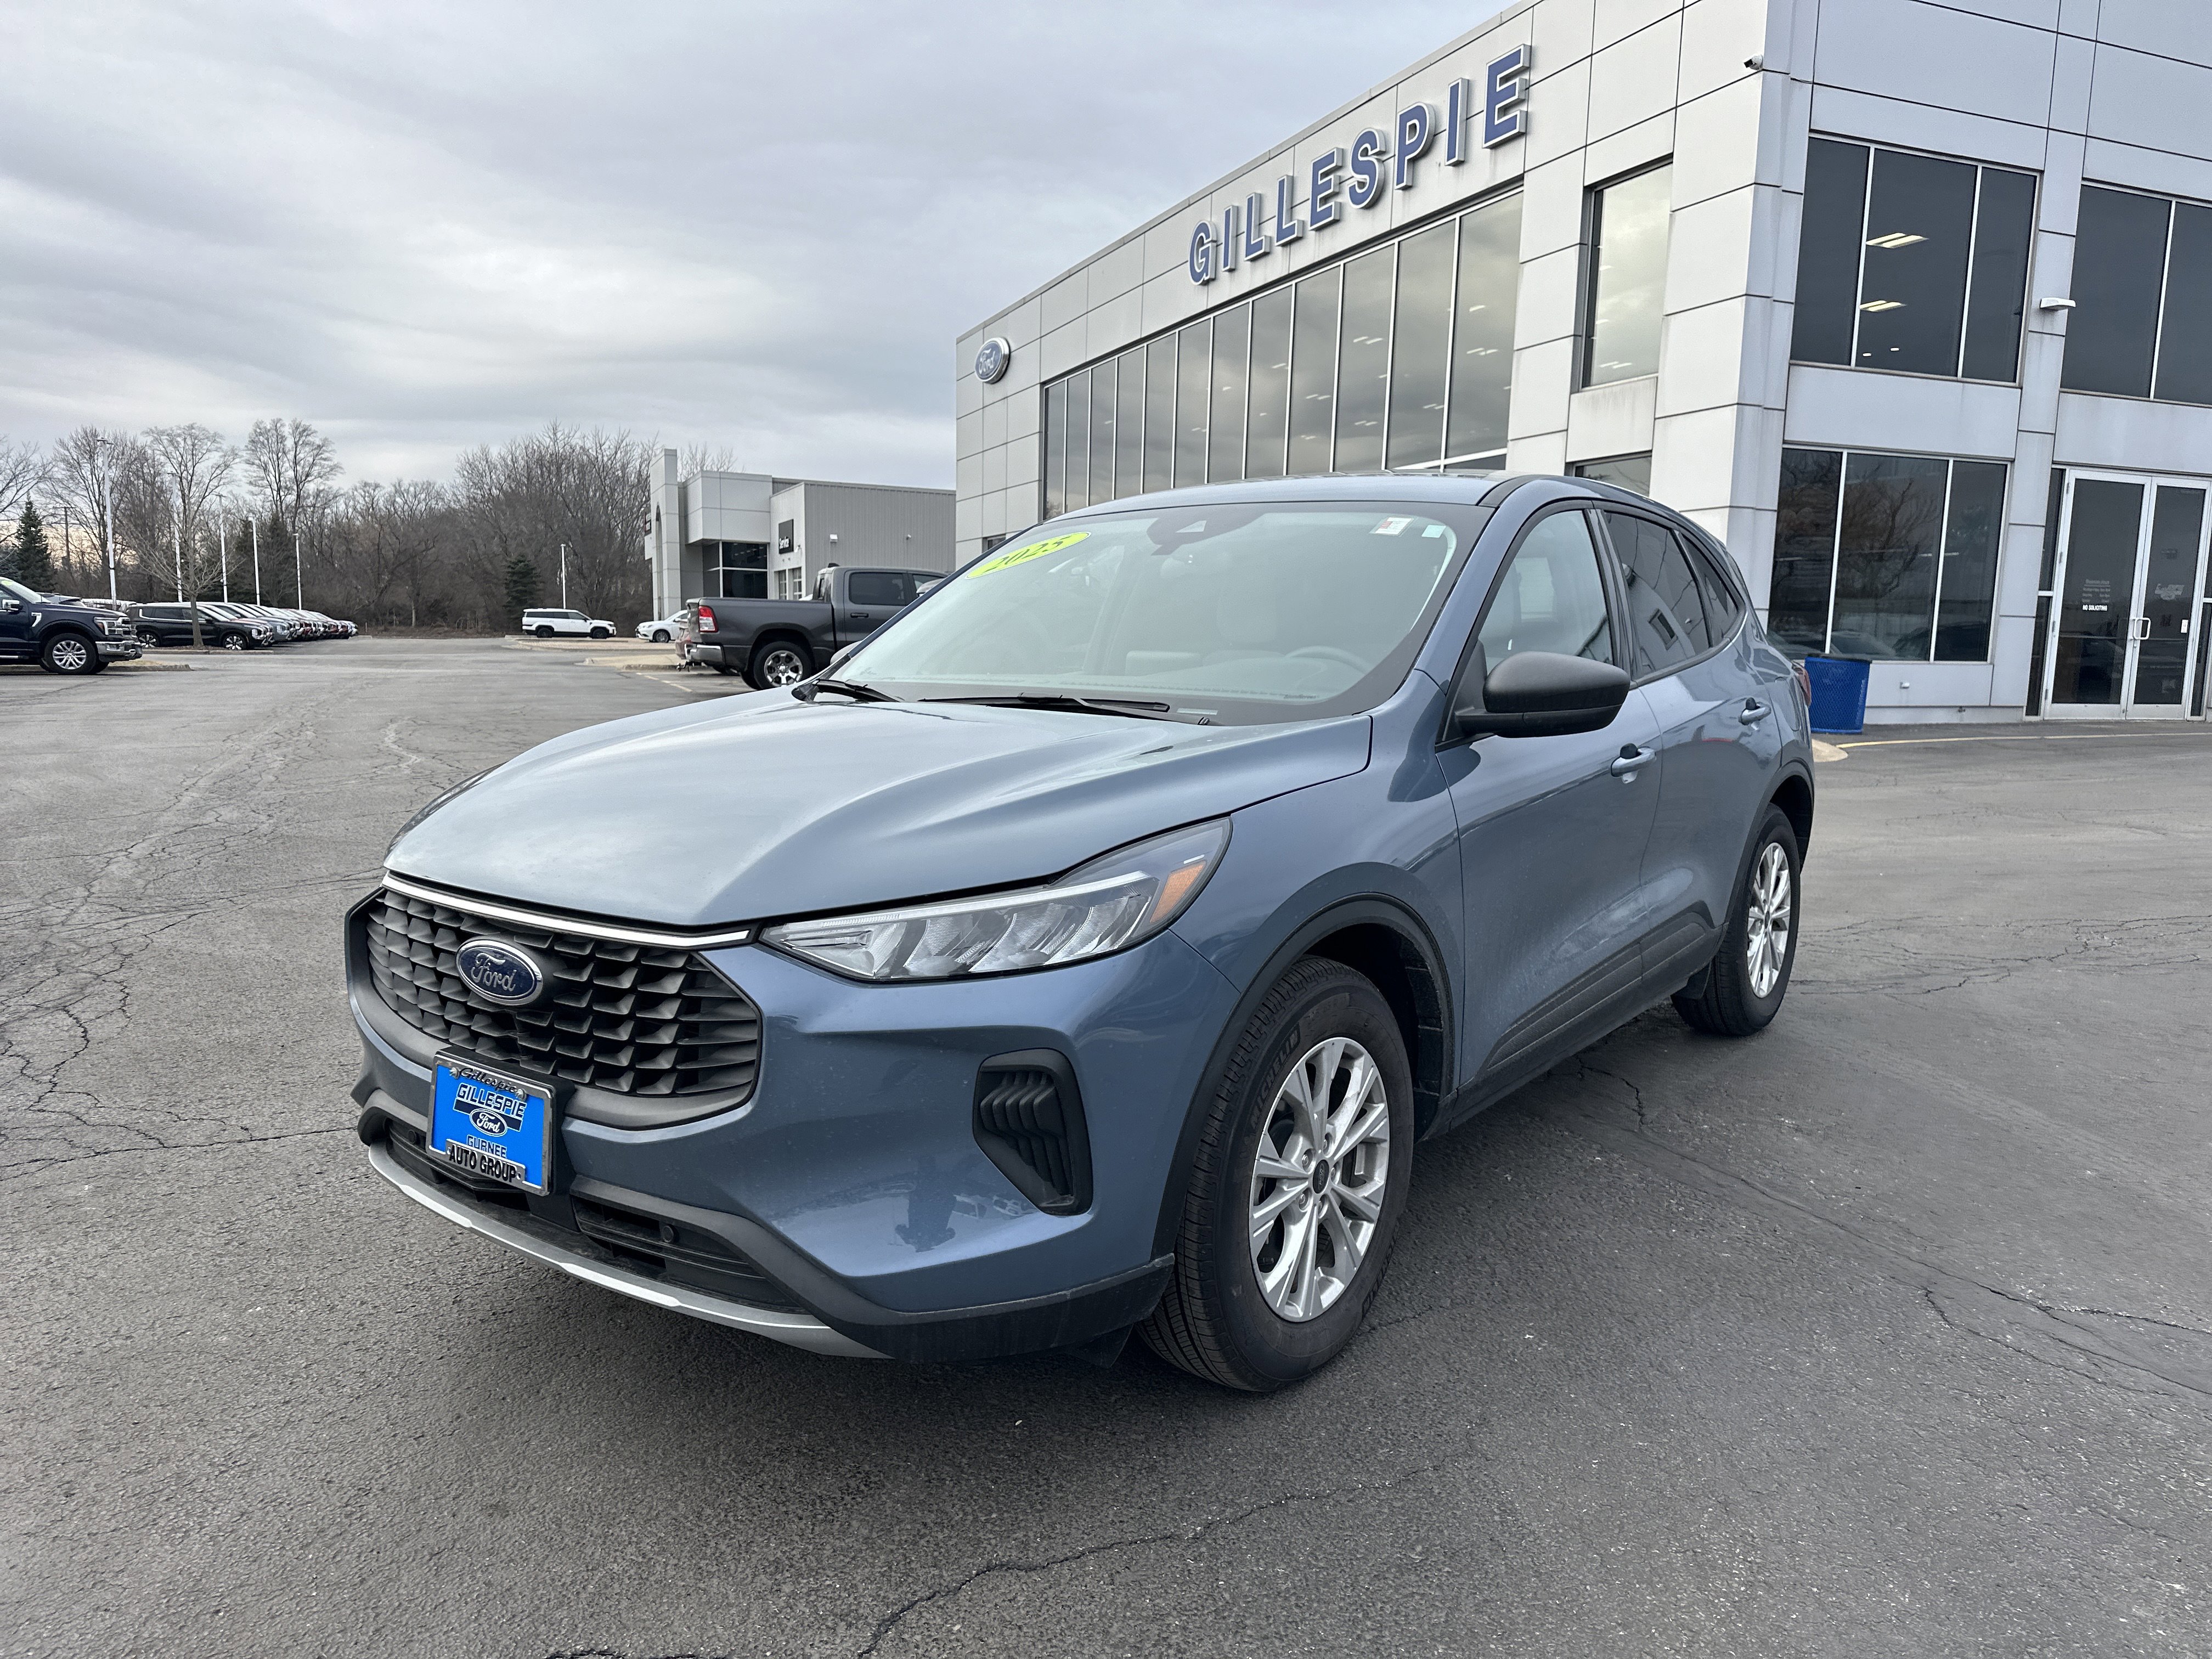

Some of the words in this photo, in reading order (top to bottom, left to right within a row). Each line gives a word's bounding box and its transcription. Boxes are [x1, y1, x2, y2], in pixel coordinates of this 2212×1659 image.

[1187, 43, 1531, 285] GILLESPIE
[981, 535, 1072, 573] 2025
[471, 952, 516, 991] Ford
[460, 1068, 517, 1093] Gillespie
[456, 1082, 527, 1118] GILLESPIE
[477, 1111, 500, 1133] Ford
[449, 1144, 477, 1169] AUTO
[480, 1154, 517, 1183] GROUP
[466, 1135, 507, 1159] GURNEE
